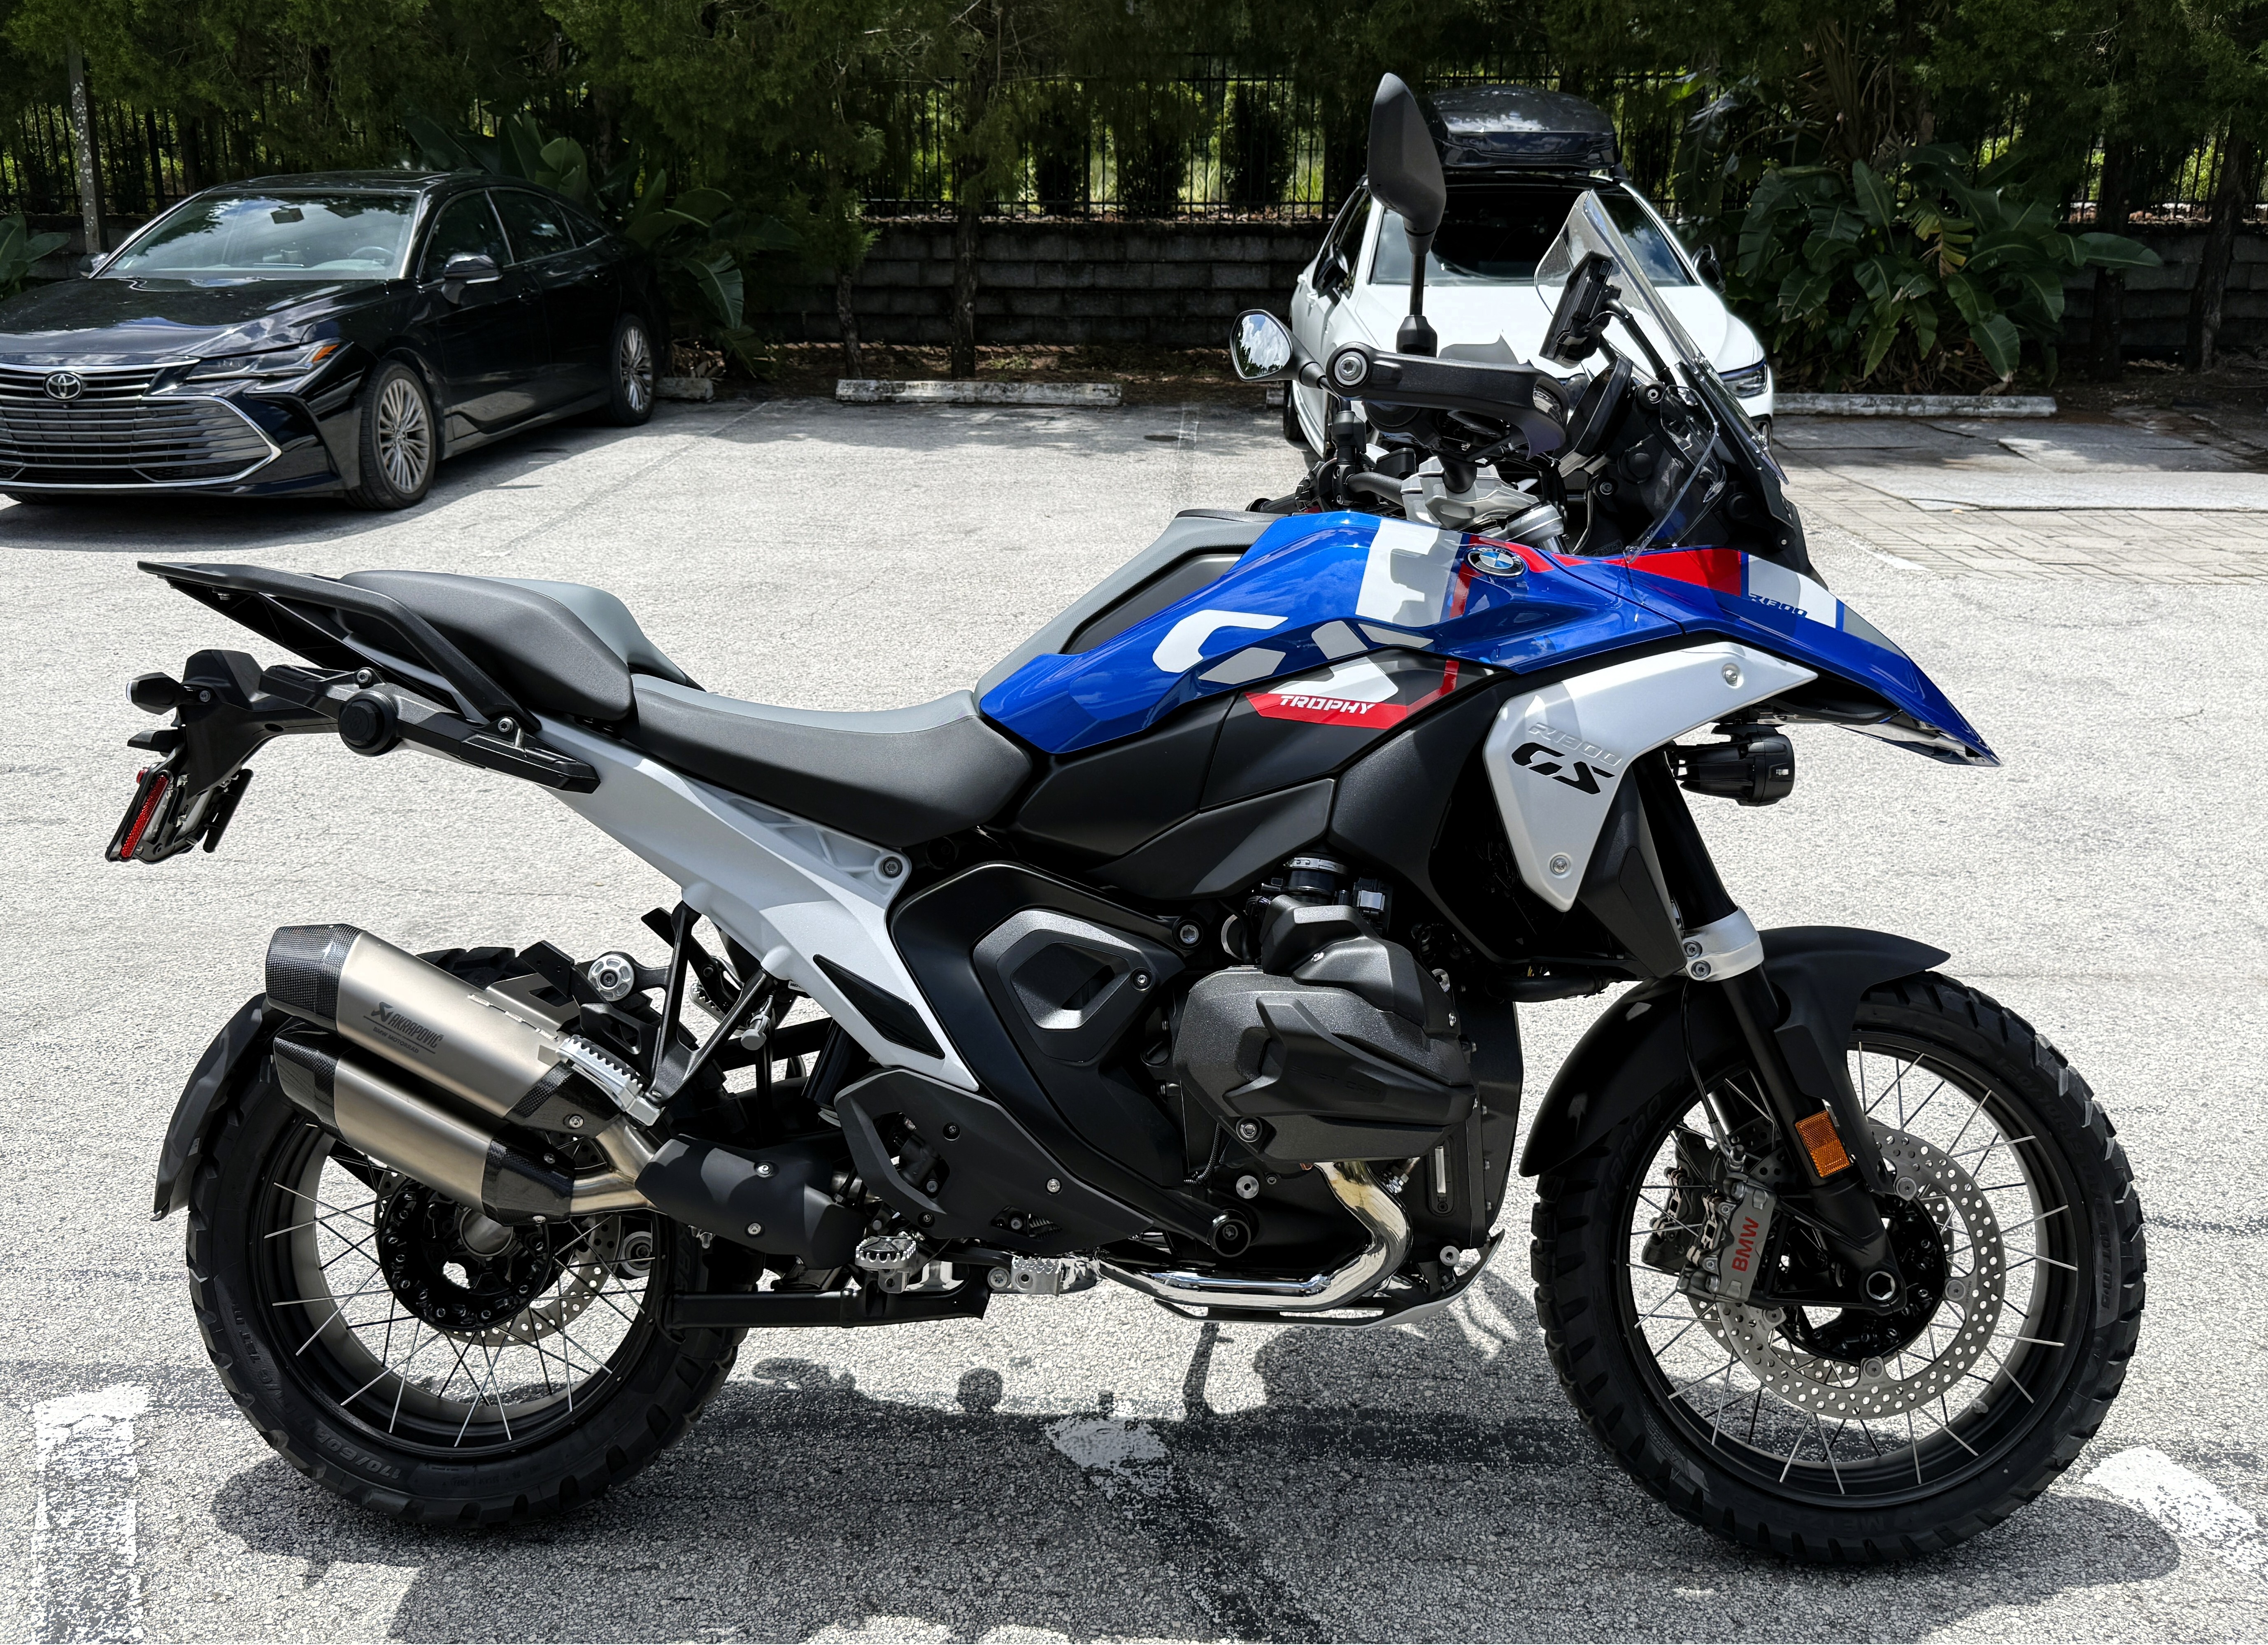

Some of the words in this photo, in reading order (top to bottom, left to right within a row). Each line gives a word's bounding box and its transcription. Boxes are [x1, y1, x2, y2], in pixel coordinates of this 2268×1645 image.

[1749, 593, 1808, 617] R1300
[1280, 695, 1376, 714] TROPHY
[1528, 722, 1622, 766] R1300
[1511, 742, 1616, 795] GS
[373, 1026, 388, 1037] BMW
[388, 1035, 419, 1053] MOTORRAD
[1289, 1065, 1339, 1083] SFT
[1597, 1094, 1666, 1211] KAROO
[1731, 1216, 1759, 1272] BMW
[295, 1414, 403, 1481] 170/60R17
